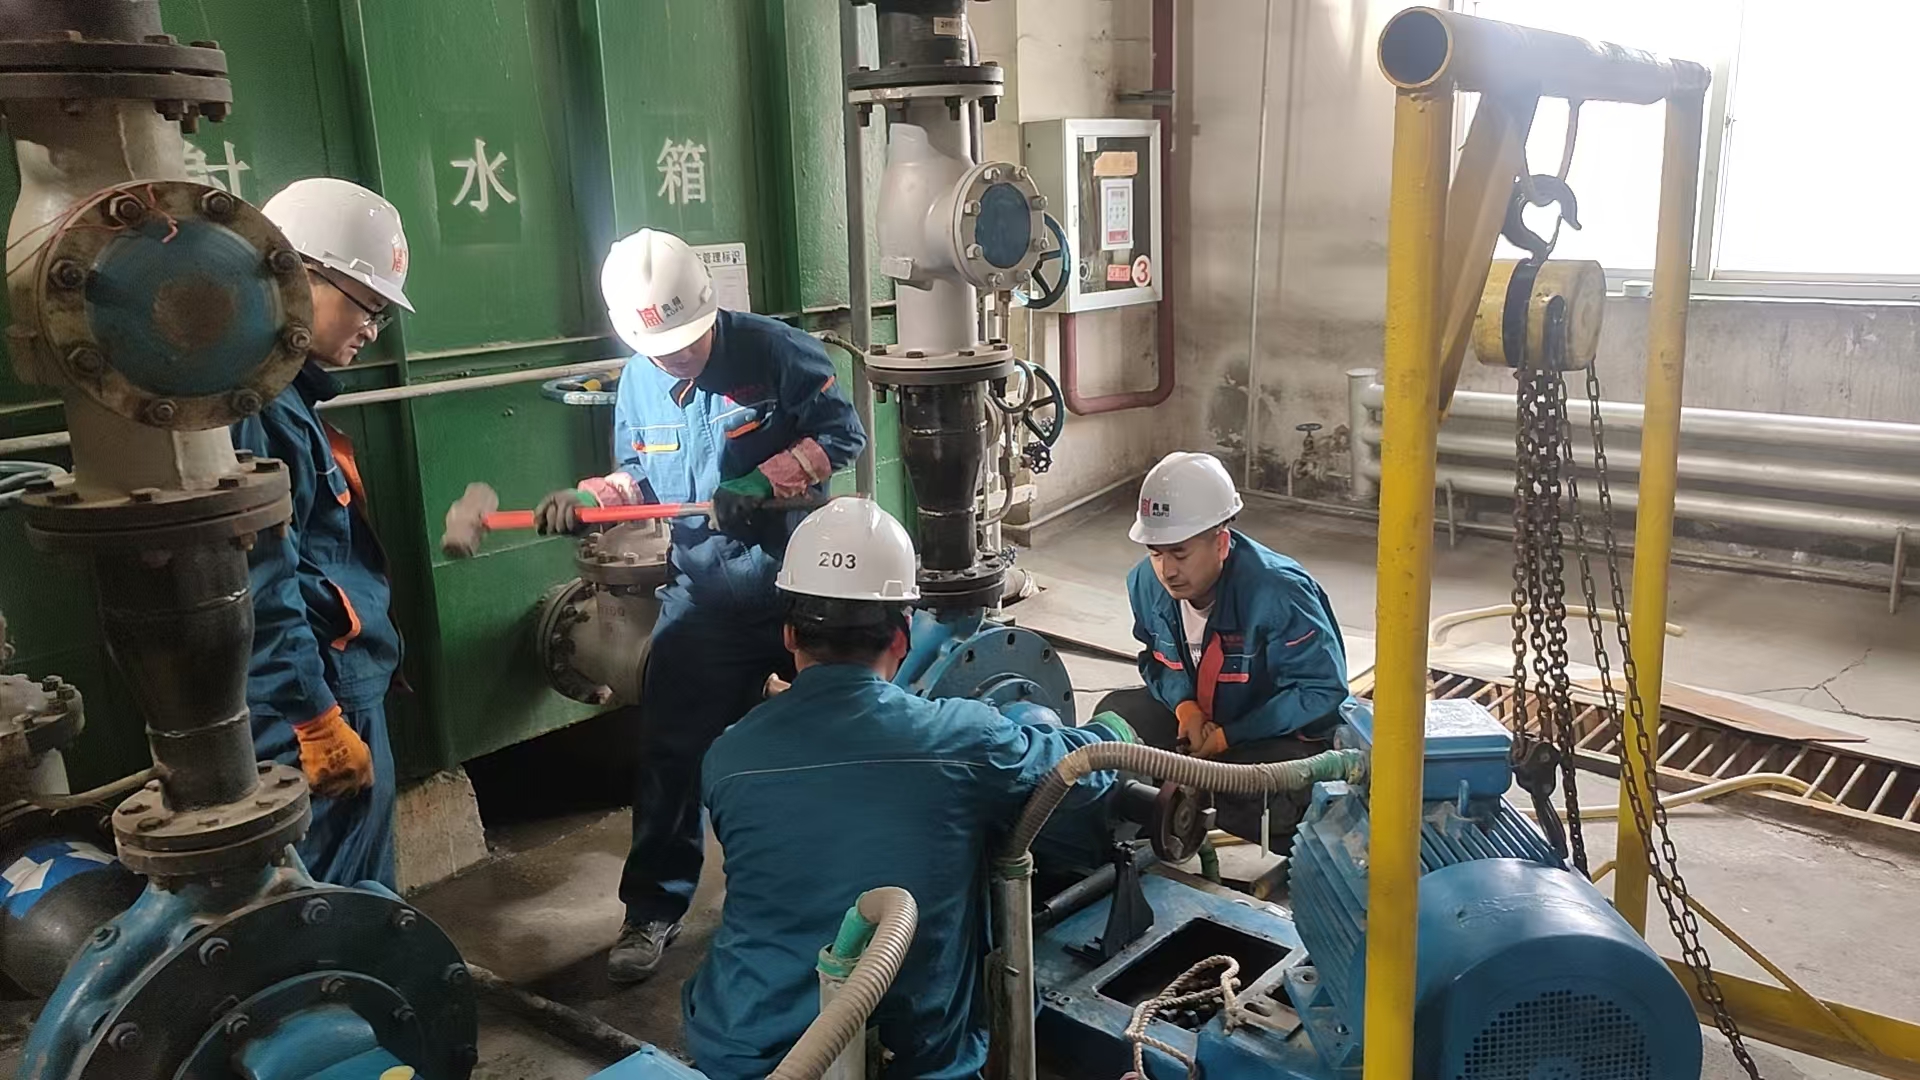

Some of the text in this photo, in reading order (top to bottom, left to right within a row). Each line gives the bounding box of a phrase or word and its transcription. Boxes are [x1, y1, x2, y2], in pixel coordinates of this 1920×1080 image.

[450, 137, 516, 212] 水
[657, 137, 706, 204] 箱
[1137, 260, 1148, 283] 3
[818, 551, 856, 569] 203
